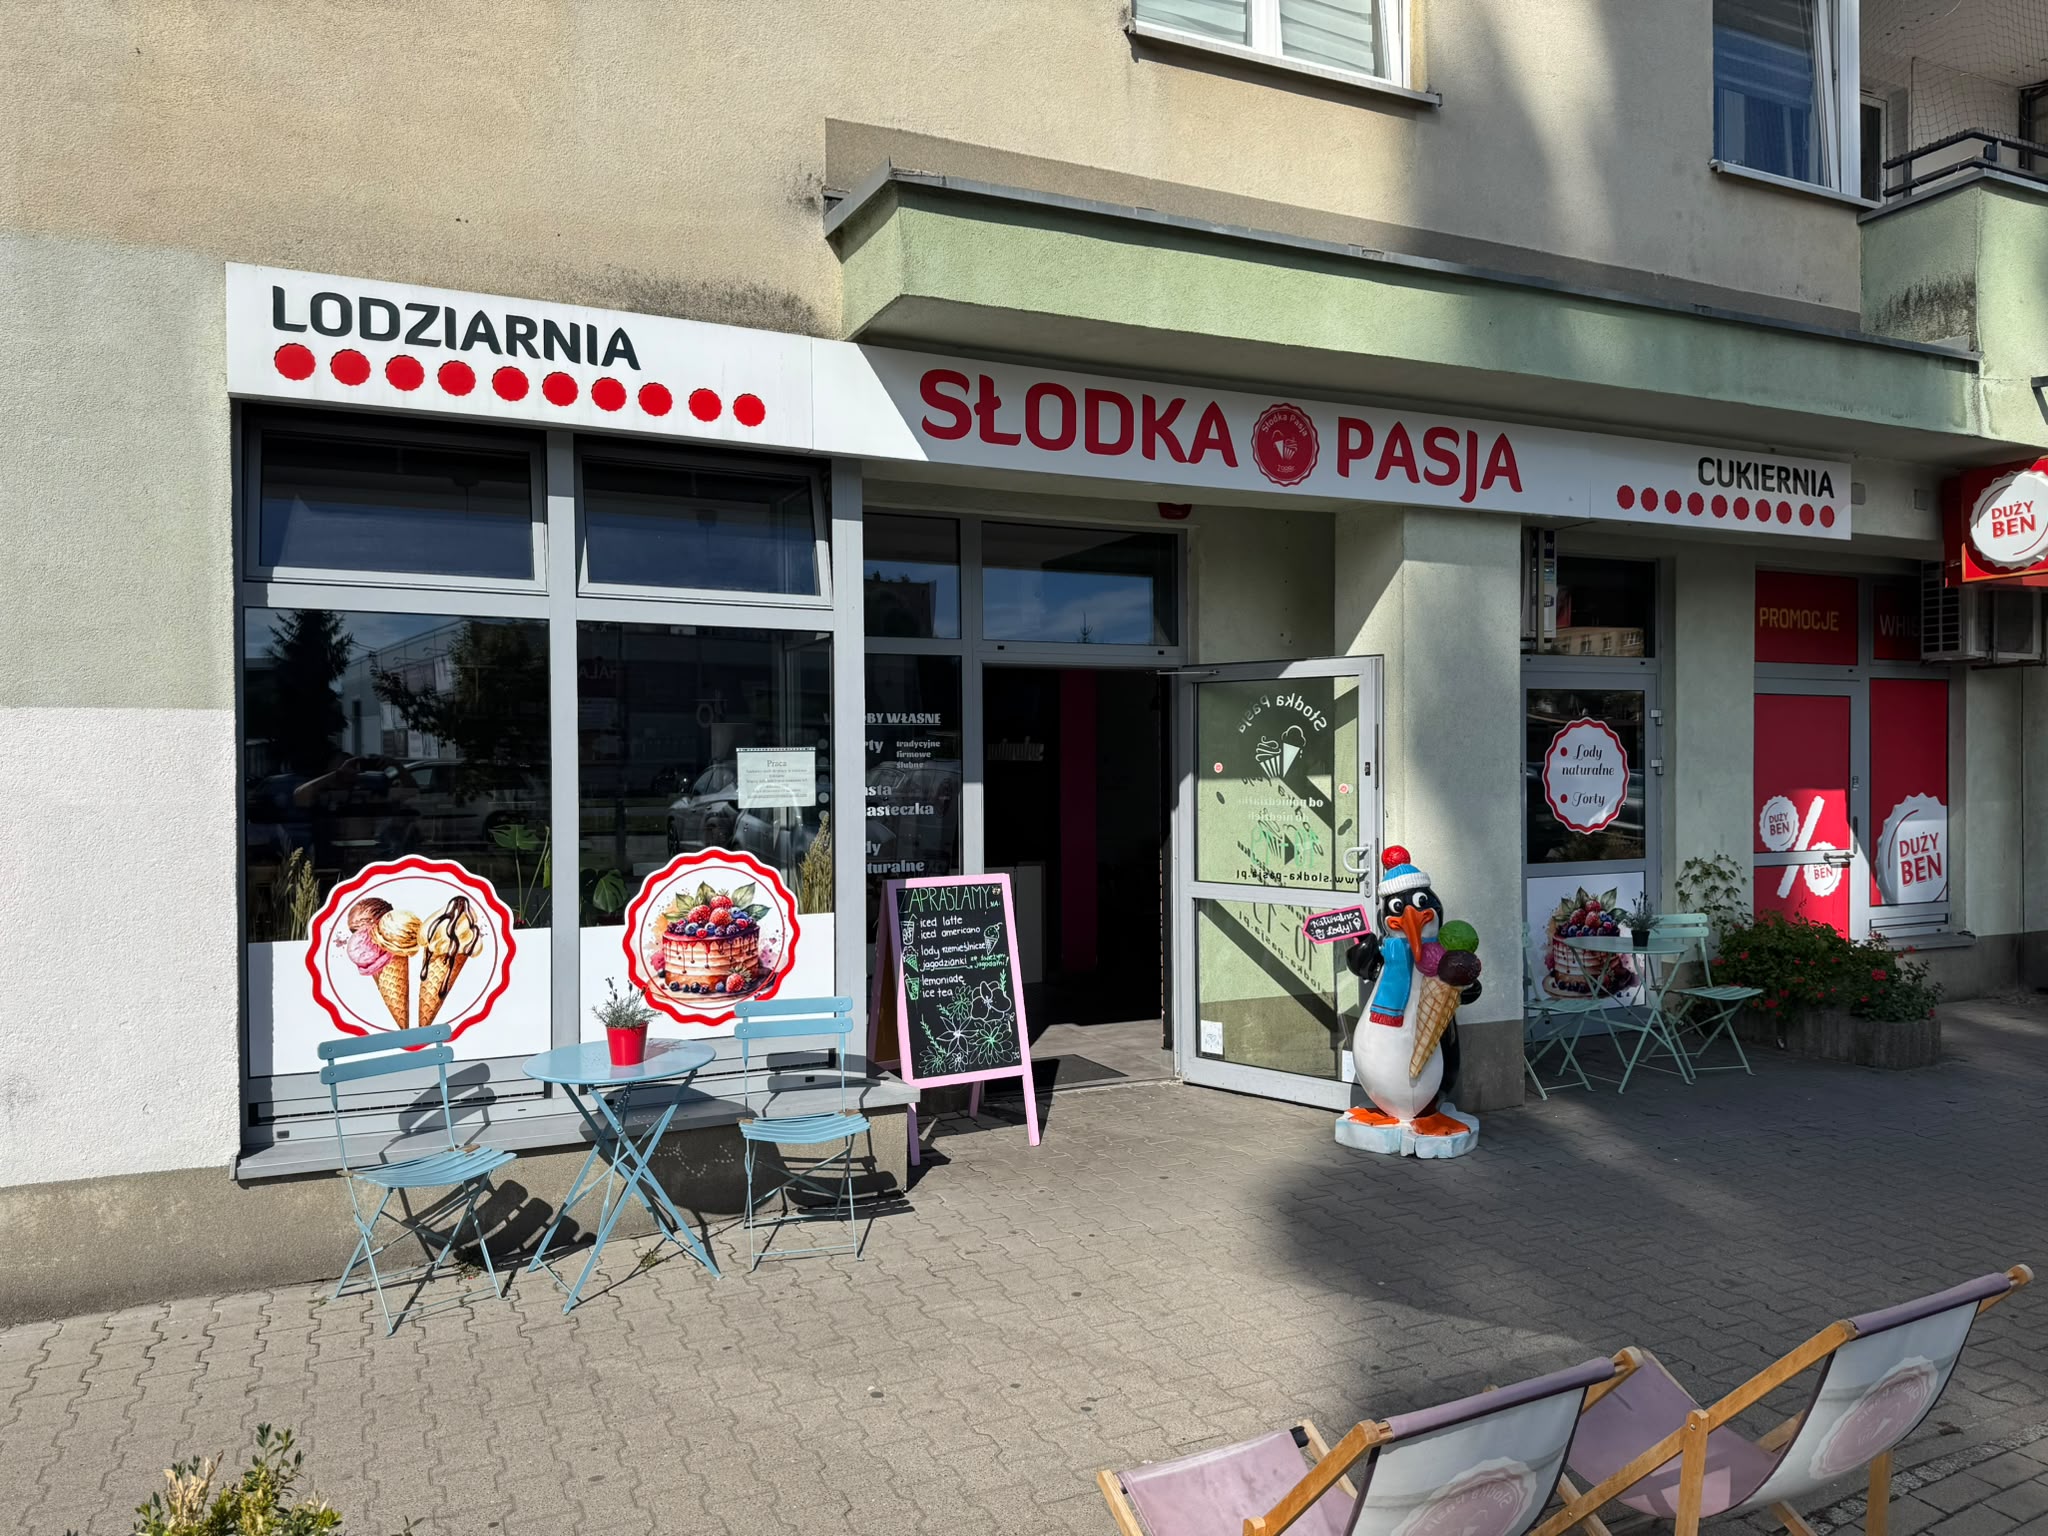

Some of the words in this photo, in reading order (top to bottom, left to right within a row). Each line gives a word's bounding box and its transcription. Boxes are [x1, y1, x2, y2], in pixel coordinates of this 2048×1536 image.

[272, 286, 641, 371] LODZIARNIA
[920, 368, 1239, 468] SŁODKA
[1337, 416, 1523, 503] PASJA
[1697, 456, 1834, 499] CUKIERNIA
[1991, 501, 2034, 520] DUŻY
[1992, 514, 2036, 538] BEN
[1759, 607, 1839, 632] PROMOCJE
[886, 712, 941, 724] WŁASNE
[896, 740, 941, 749] tradycyjne
[1573, 743, 1603, 761] Lody
[896, 750, 932, 758] firmowe
[766, 760, 787, 768] Praca
[1561, 762, 1615, 776] naturalne
[1571, 791, 1606, 807] Torty
[866, 802, 934, 817] asteczka
[1769, 812, 1789, 824] DUŻY
[1769, 821, 1790, 836] BEN
[1899, 831, 1939, 859] DUŻY
[866, 859, 925, 874] turalne
[1813, 867, 1834, 880] BEN
[1900, 853, 1943, 887] BEN
[899, 886, 990, 914] ZAPRASZAMY
[920, 917, 937, 928] iced
[942, 914, 963, 926] latte
[920, 928, 937, 940] iced
[941, 927, 981, 938] americano
[920, 944, 940, 960] lody
[920, 954, 967, 972] jagodzianki
[922, 989, 937, 998] ice
[937, 988, 953, 998] tea
